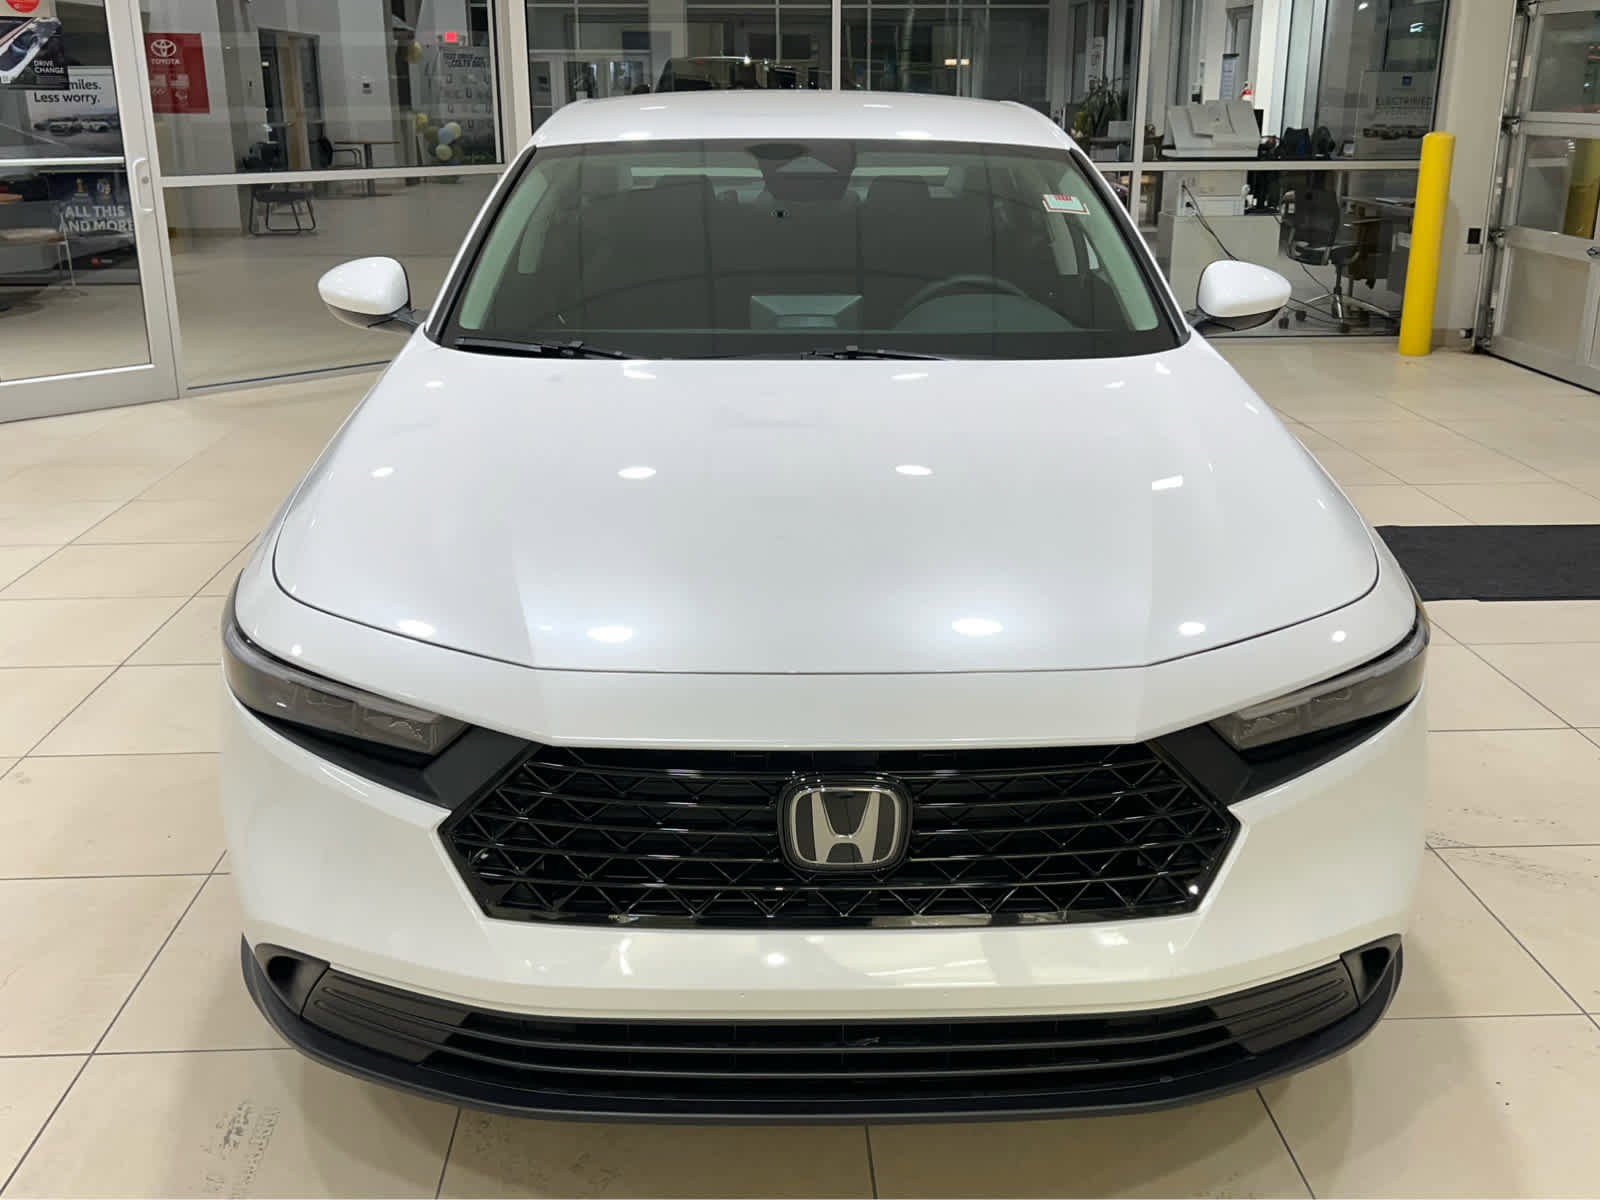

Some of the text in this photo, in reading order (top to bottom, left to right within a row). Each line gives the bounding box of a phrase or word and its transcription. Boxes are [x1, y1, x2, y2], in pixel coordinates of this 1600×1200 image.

[33, 92, 101, 105] Less worry.
[65, 205, 125, 219] ALL THIS
[59, 219, 135, 233] AND MORE
